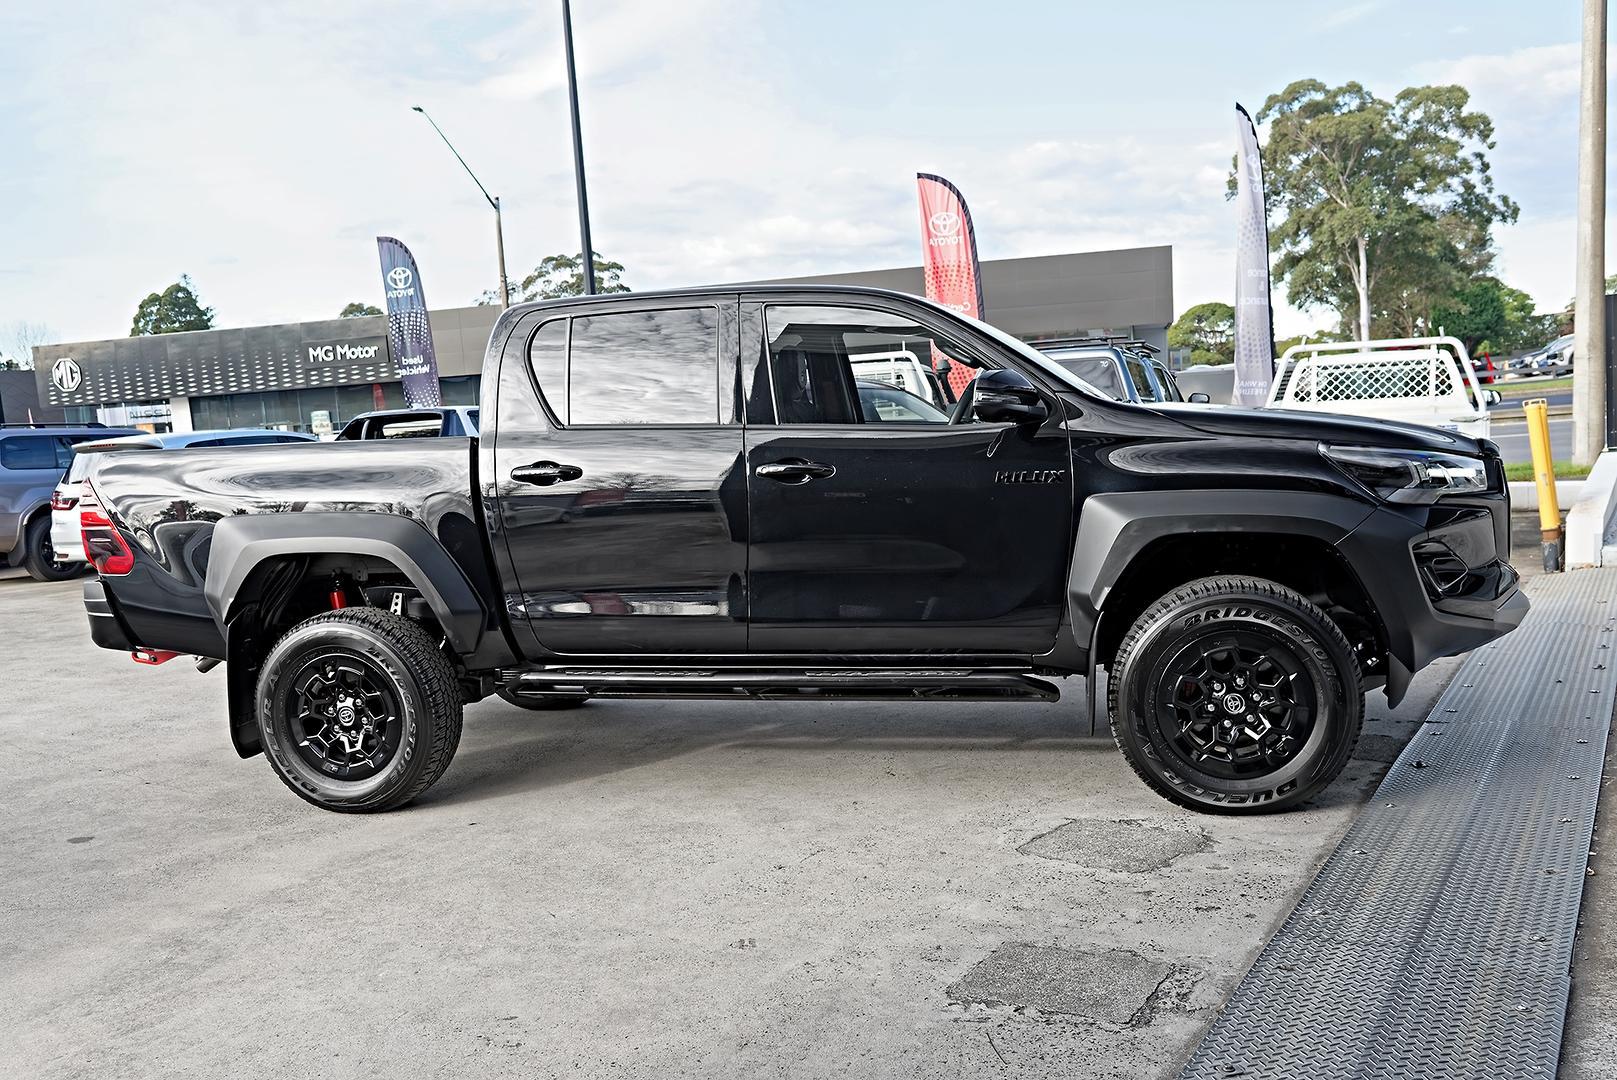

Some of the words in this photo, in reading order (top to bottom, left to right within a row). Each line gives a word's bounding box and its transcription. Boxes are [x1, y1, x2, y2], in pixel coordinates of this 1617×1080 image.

[308, 346, 335, 362] MG
[336, 343, 379, 360] Motor
[54, 360, 80, 390] MG
[130, 409, 171, 418] NISSA
[995, 470, 1065, 484] HILUX
[1162, 768, 1299, 804] DUELER
